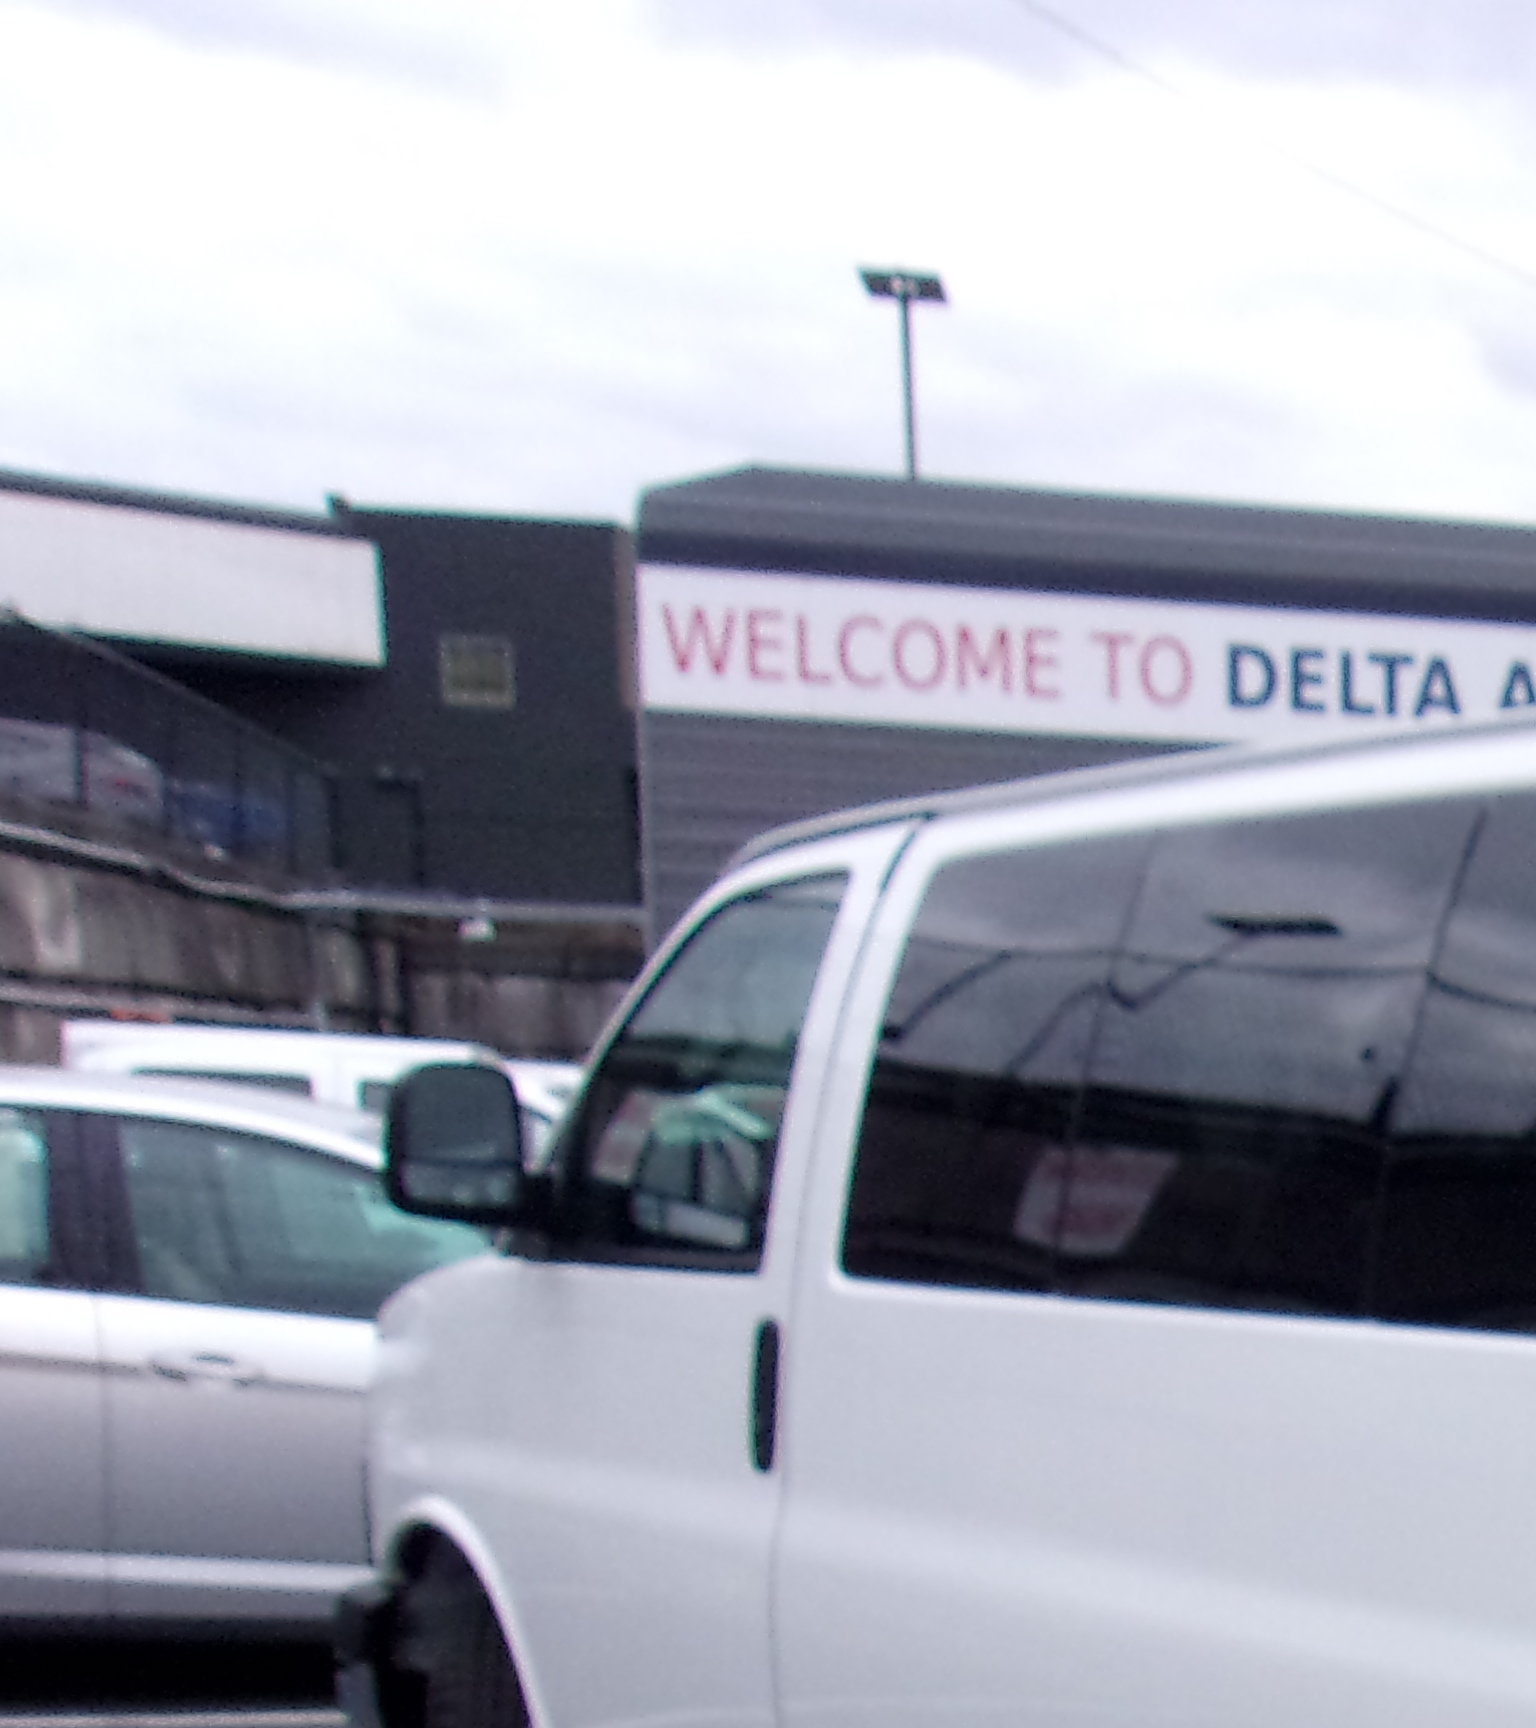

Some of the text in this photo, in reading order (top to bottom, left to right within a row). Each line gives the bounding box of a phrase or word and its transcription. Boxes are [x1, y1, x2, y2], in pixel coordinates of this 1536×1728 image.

[662, 602, 1064, 701] WELCOME
[1091, 629, 1194, 706] TO
[1226, 642, 1462, 717] DELTA
